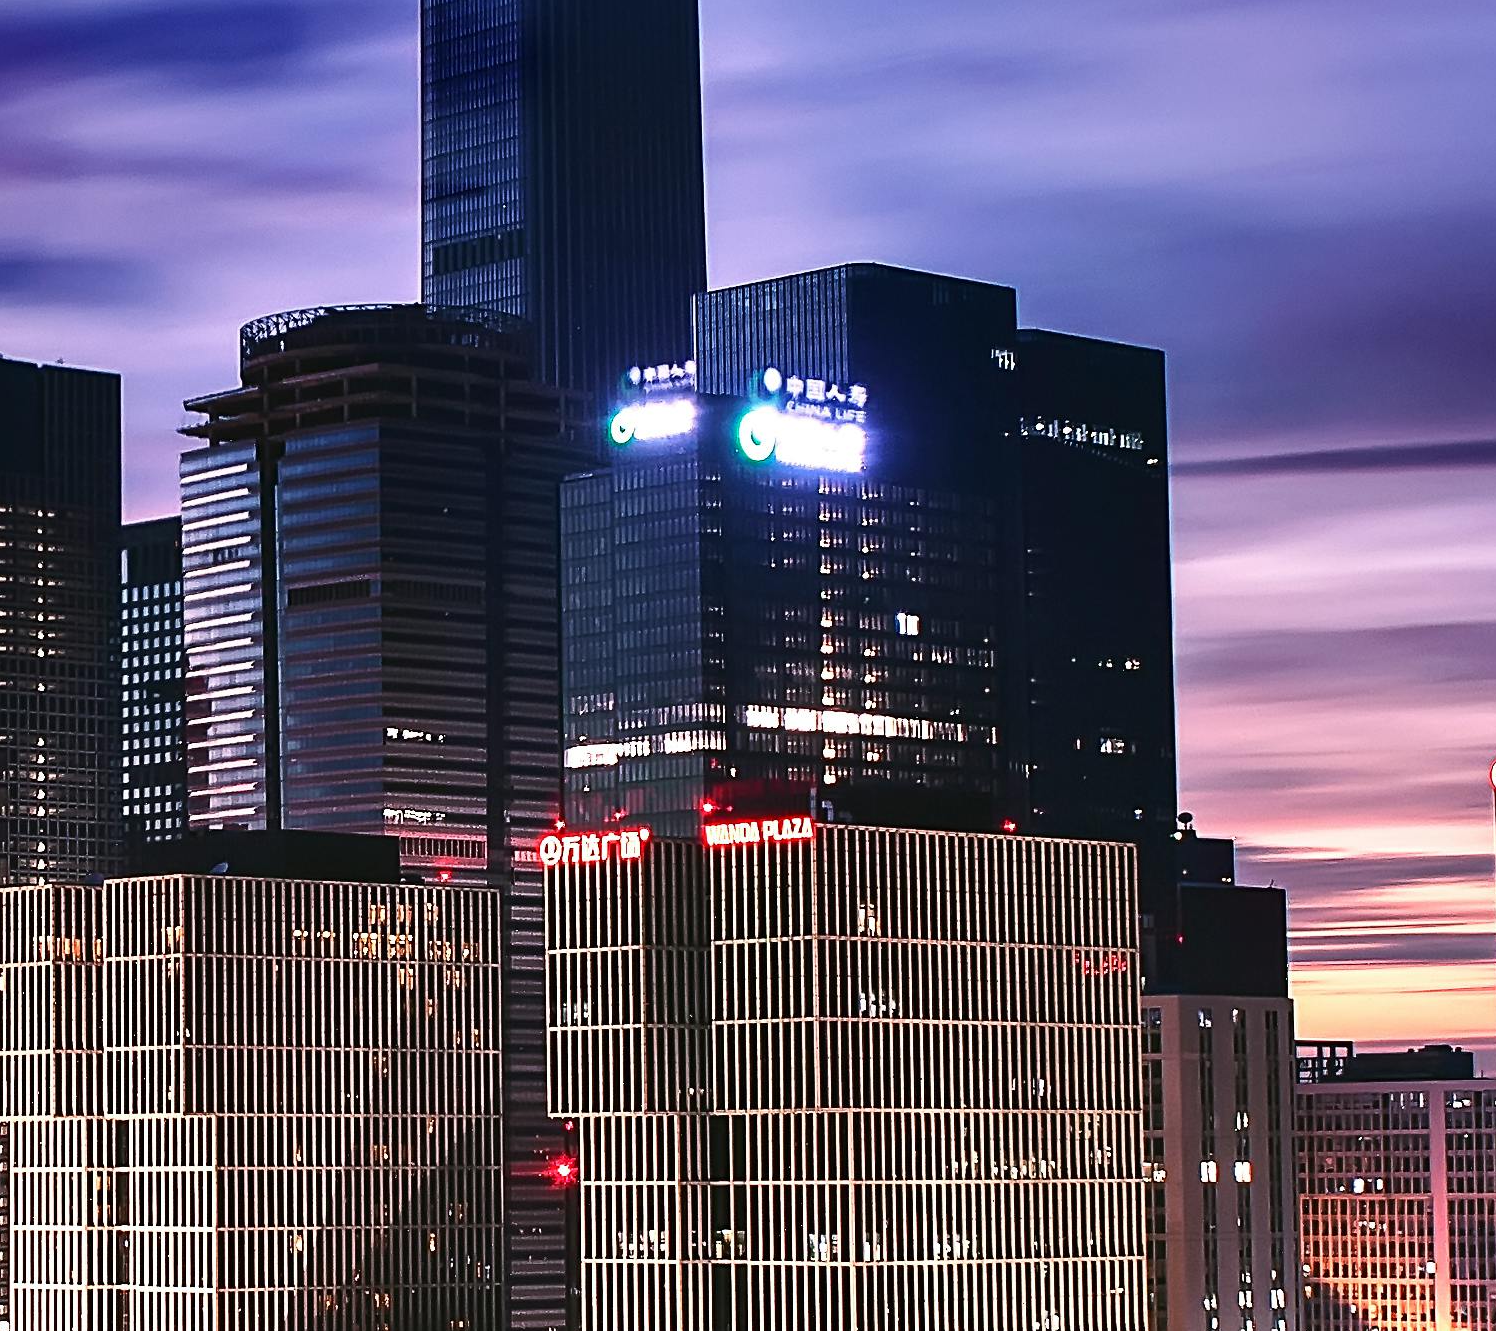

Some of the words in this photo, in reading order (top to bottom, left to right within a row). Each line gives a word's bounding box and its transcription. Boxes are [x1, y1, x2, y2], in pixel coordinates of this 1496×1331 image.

[561, 830, 641, 863] 万达广场
[705, 821, 761, 846] WANDA
[762, 817, 814, 841] PLAZA
